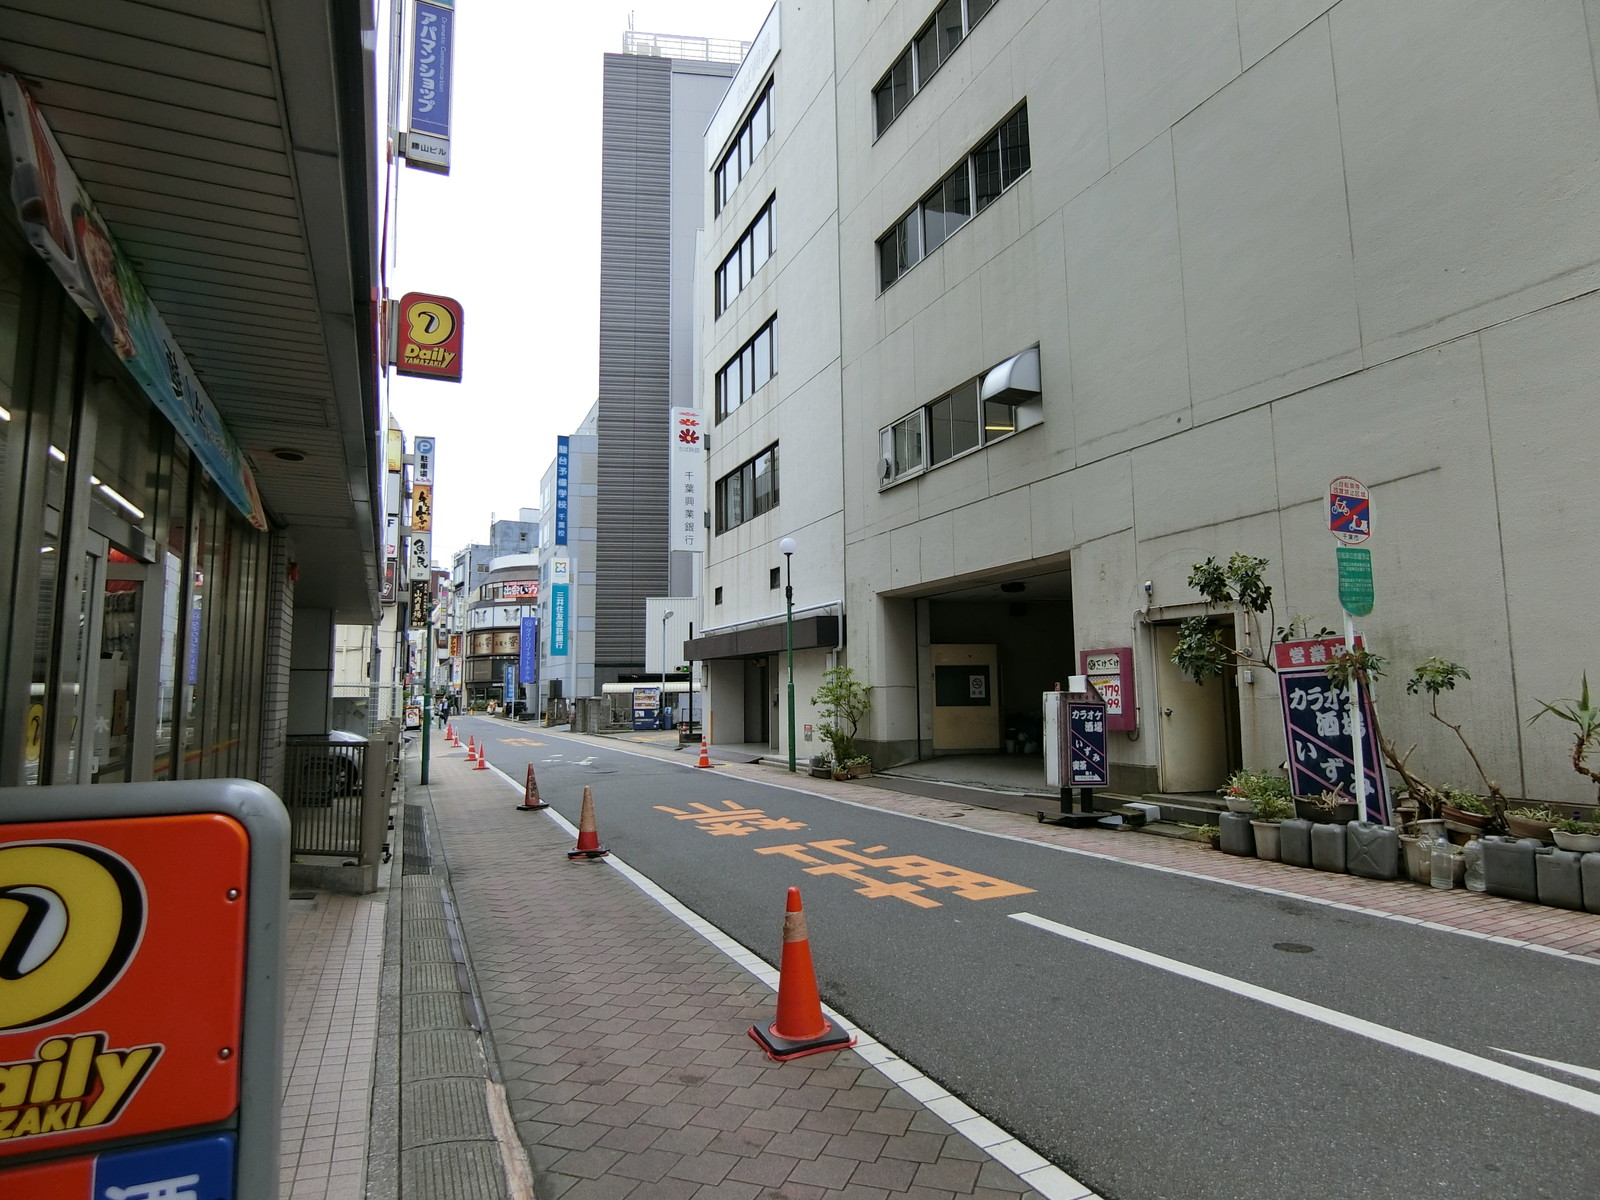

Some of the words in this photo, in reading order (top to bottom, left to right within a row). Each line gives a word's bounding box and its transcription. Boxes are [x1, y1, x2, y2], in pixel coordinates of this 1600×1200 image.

[440, 16, 448, 45] Dramatic
[418, 11, 437, 113] アパマンショップ
[439, 47, 447, 93] Communication
[411, 141, 447, 156] 勝山ビル
[404, 343, 457, 368] Daily
[404, 357, 442, 367] YAMAZAKI
[419, 455, 429, 478] 駐車場
[557, 445, 568, 509] 駿台予備学校
[684, 471, 695, 546] 千葉興業銀行
[557, 513, 566, 537] 千葉校
[414, 538, 429, 568] 魚民
[555, 592, 565, 649] 三井住友信託銀行
[1095, 659, 1120, 668] てけてけ
[1104, 684, 1120, 697] 179
[1071, 709, 1103, 721] カラオケ
[1084, 721, 1104, 733] 酒場
[1075, 739, 1101, 763] いずみ
[1295, 739, 1375, 797] いずみ
[0, 1031, 165, 1127] aily
